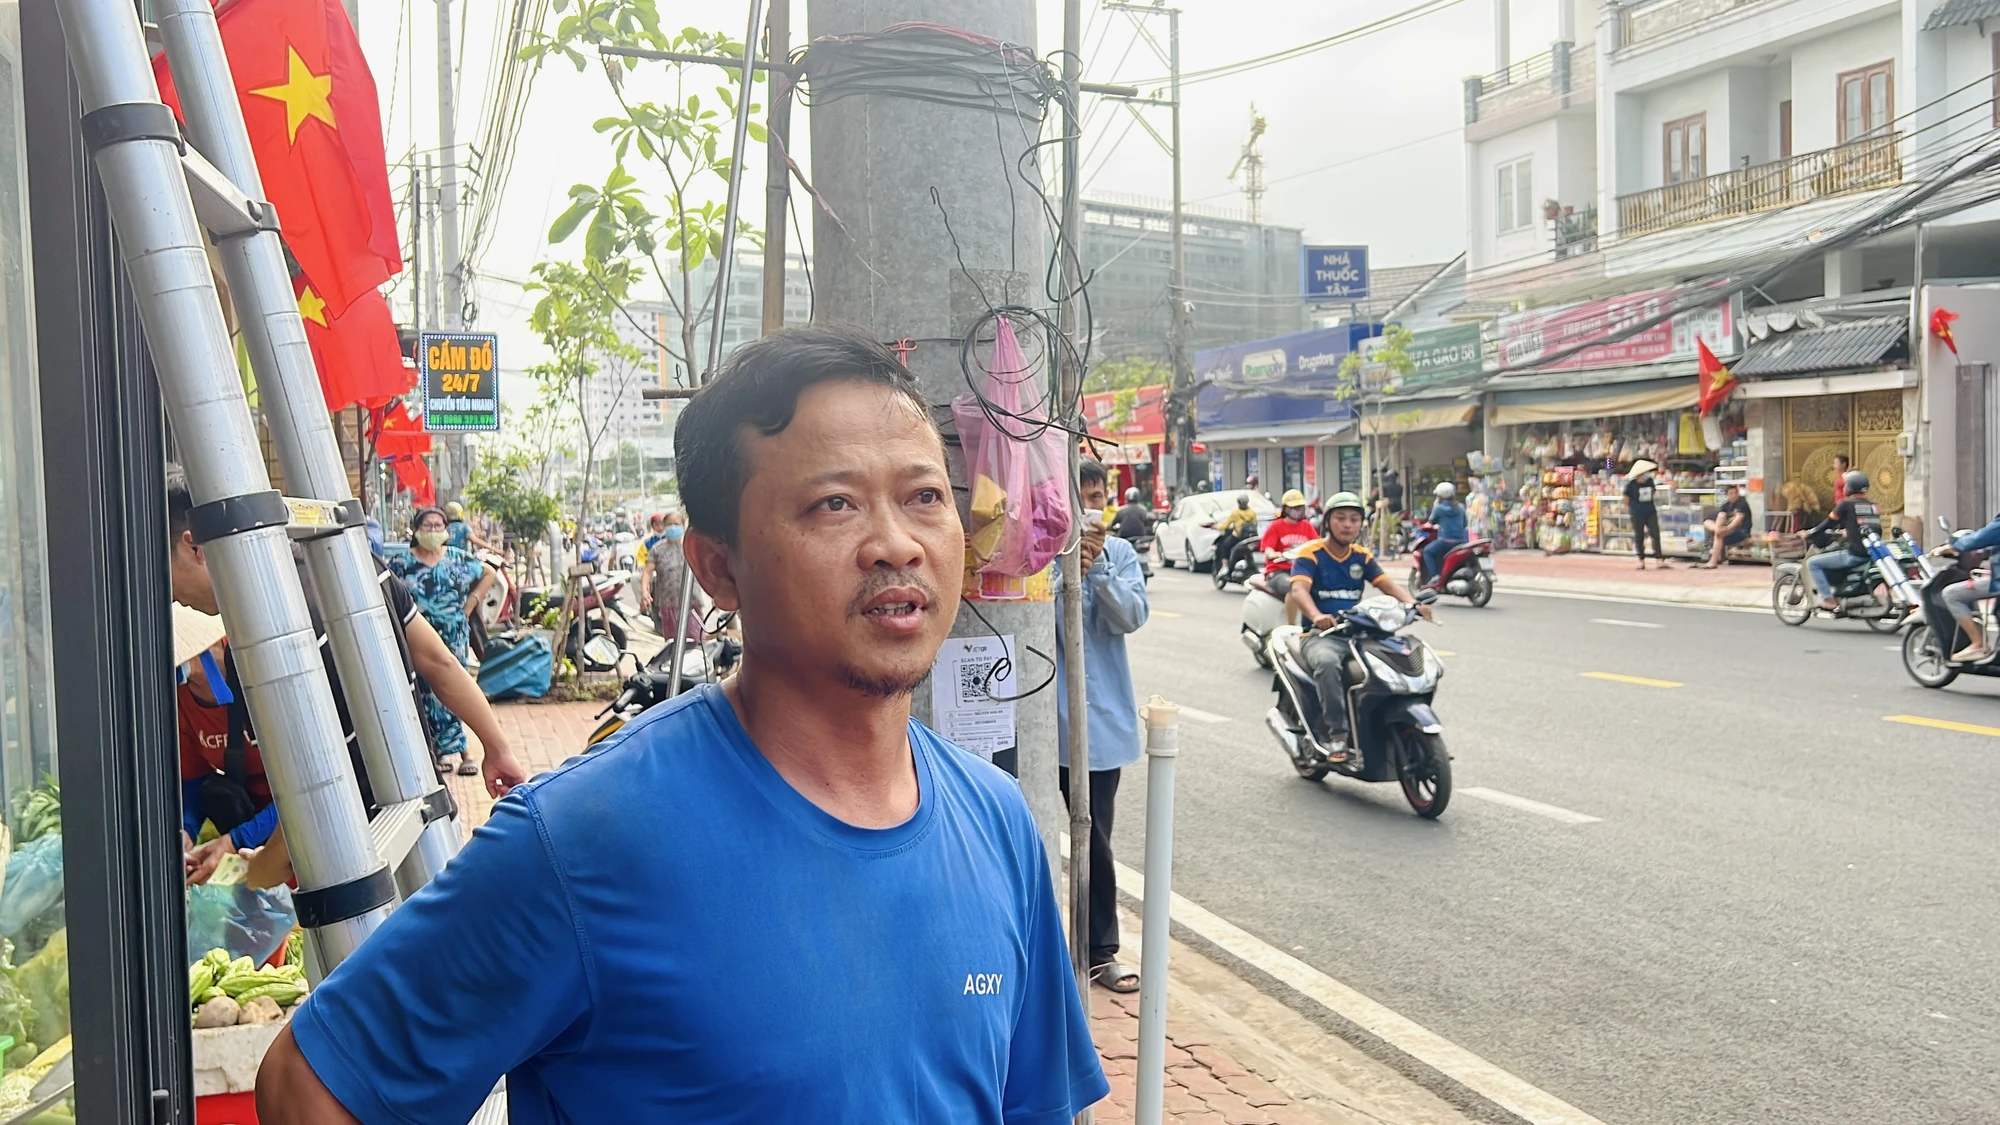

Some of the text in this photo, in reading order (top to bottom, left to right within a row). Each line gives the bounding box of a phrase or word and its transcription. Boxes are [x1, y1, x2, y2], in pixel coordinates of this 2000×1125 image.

[1315, 264, 1359, 281] THUỐC
[442, 373, 480, 392] 24/7
[963, 973, 1003, 996] AGXY
